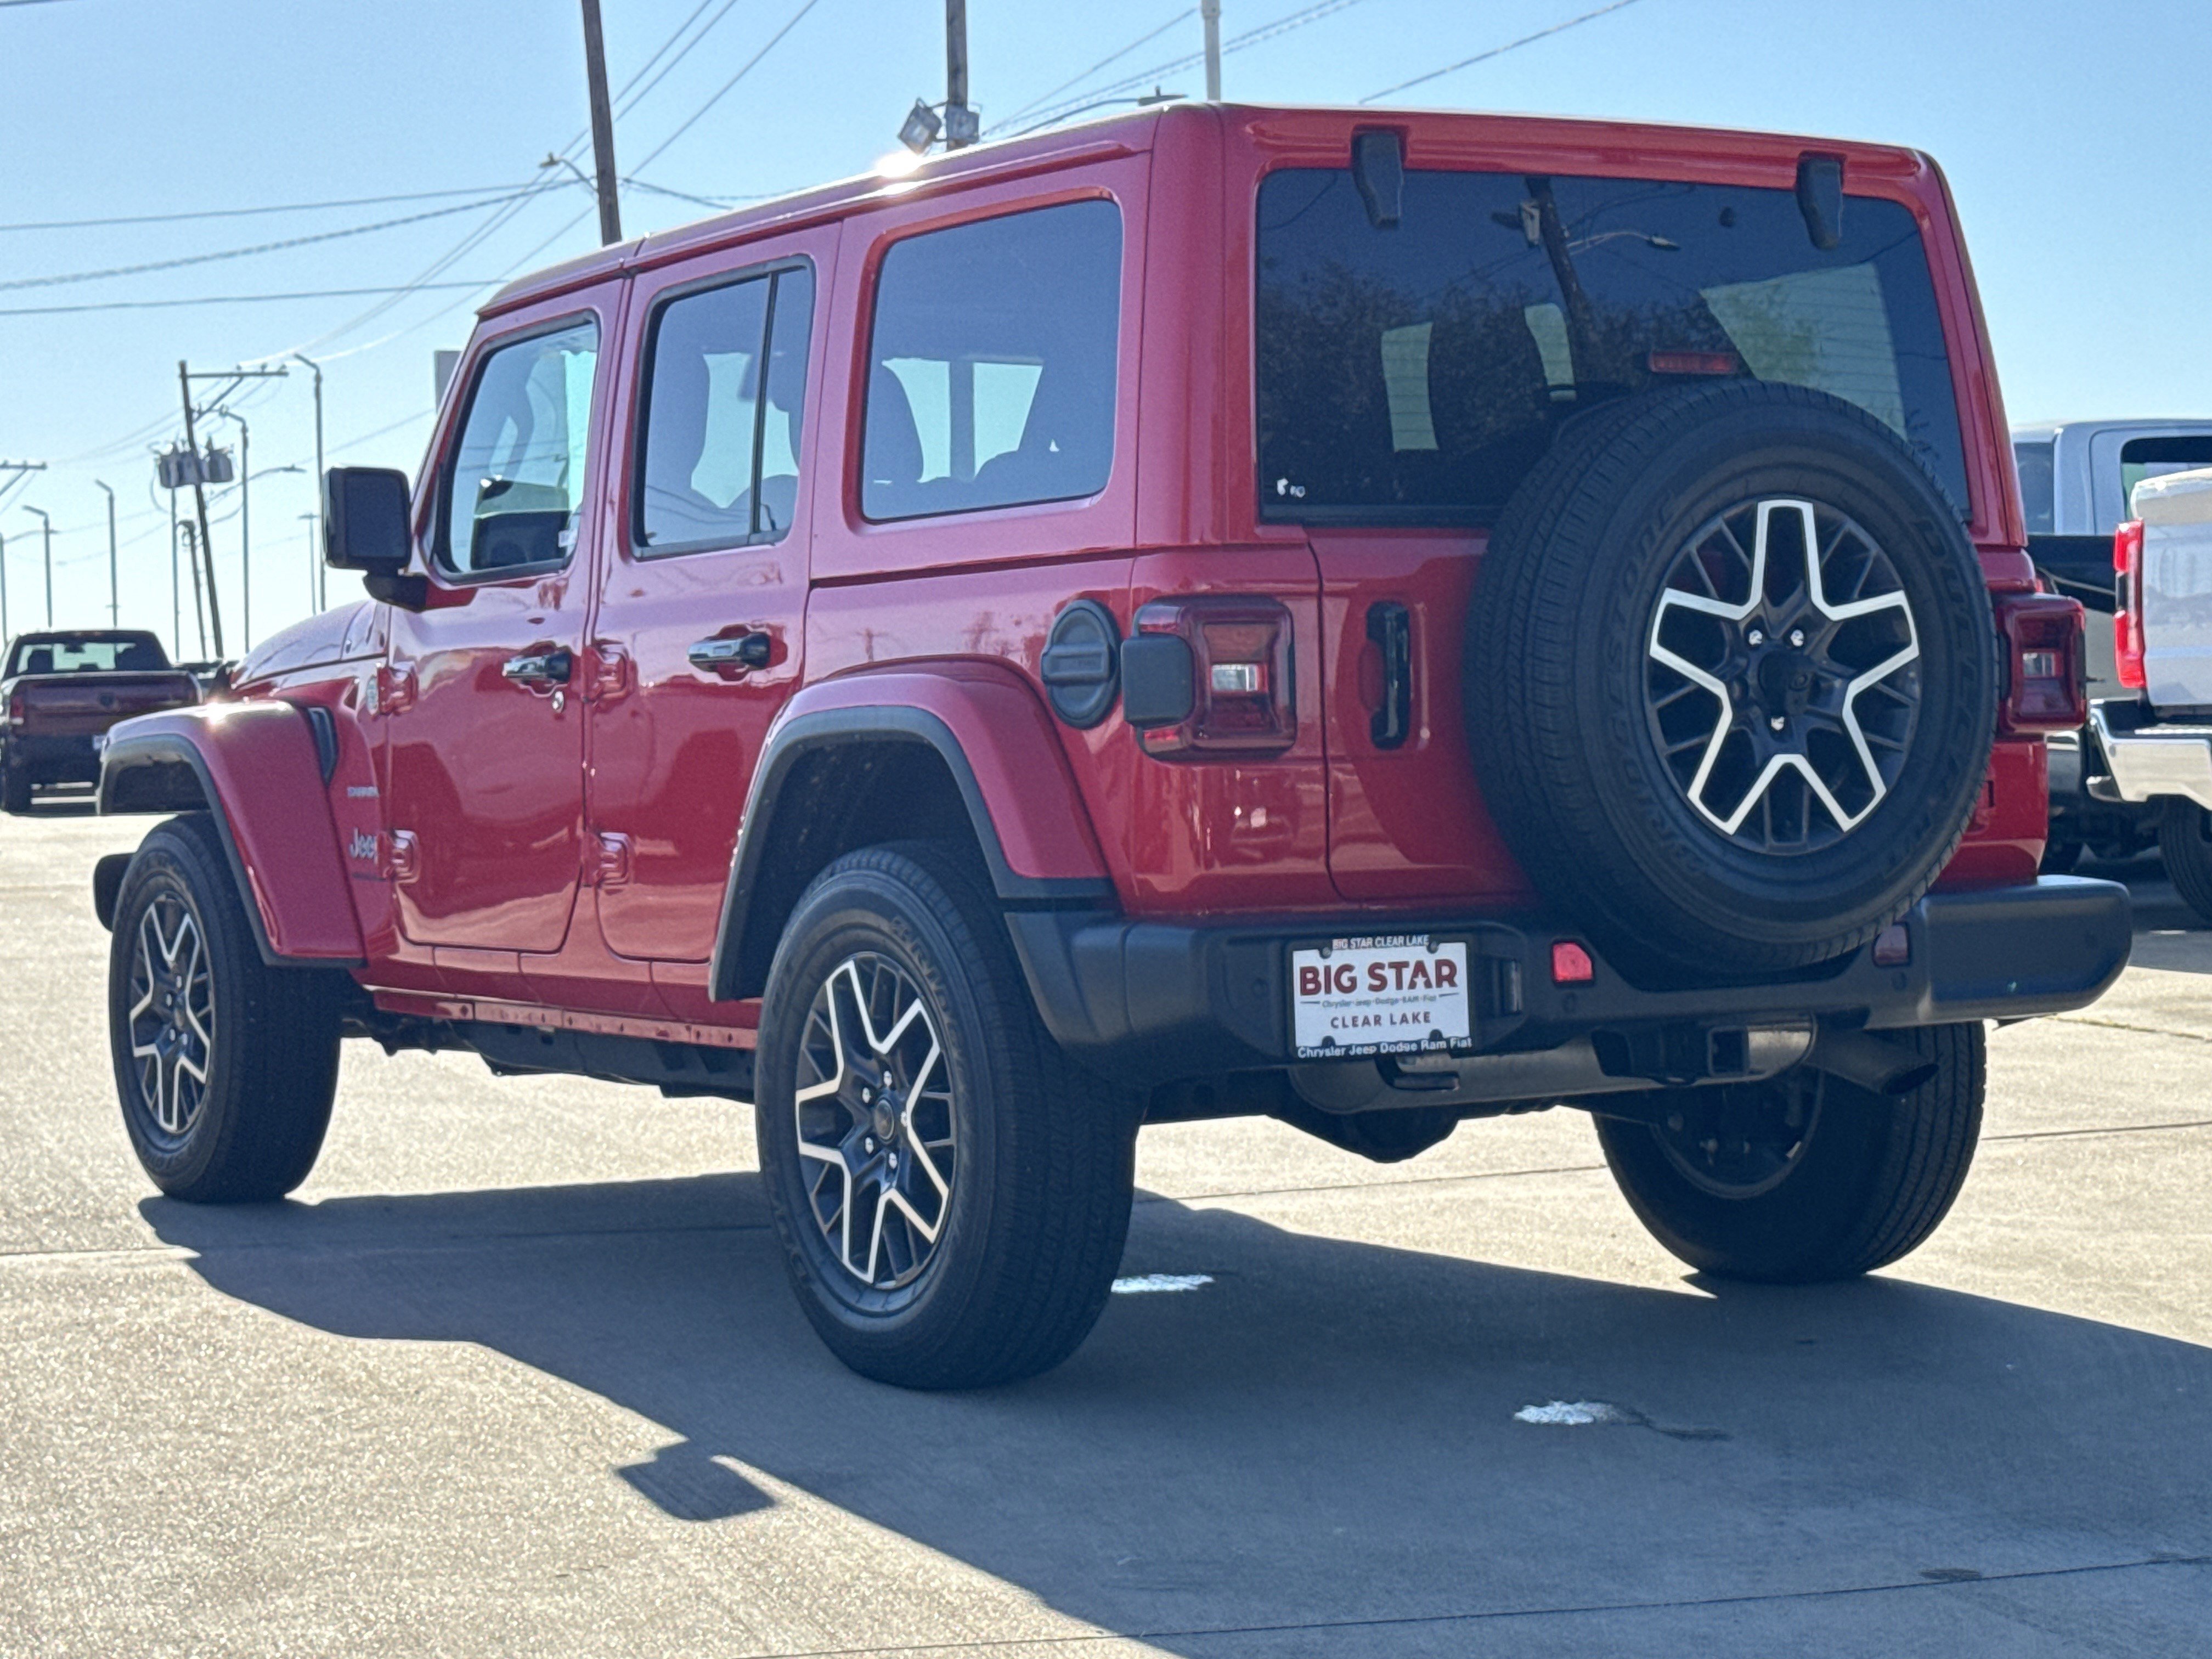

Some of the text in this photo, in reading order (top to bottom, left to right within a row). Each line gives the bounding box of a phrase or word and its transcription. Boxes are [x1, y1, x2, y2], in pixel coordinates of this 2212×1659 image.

[1333, 934, 1430, 950] BIG STAR CLEAR LAKE
[1300, 958, 1458, 996] BIG STAR
[1330, 1011, 1431, 1029] CLEAR LAKE
[1297, 1036, 1472, 1059] Chrysler Jeep Dodge Ram Fiat
